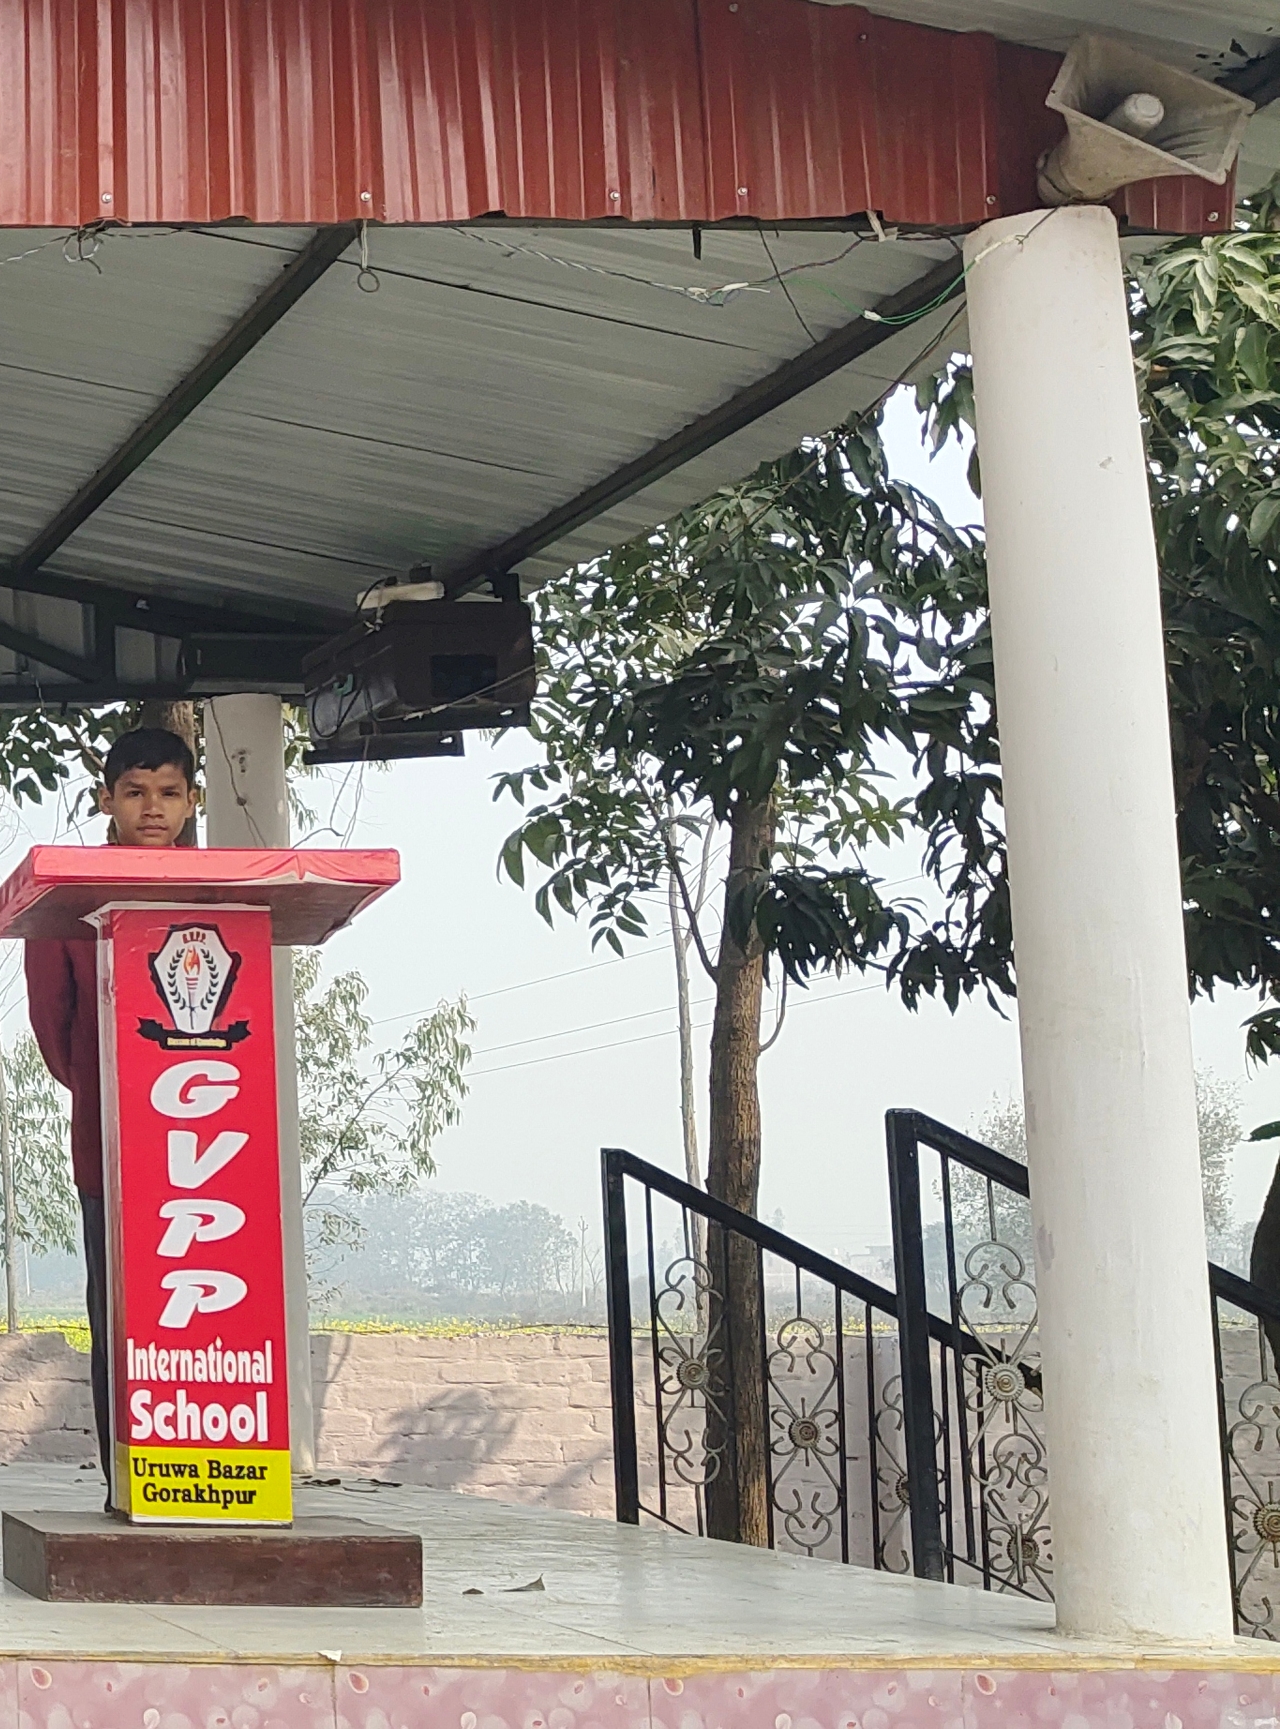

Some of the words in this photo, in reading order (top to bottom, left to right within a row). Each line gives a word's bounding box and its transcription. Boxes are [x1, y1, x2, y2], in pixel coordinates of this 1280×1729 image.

[127, 1335, 273, 1384] International
[130, 1389, 269, 1443] School
[132, 1457, 200, 1479] Uruwa
[206, 1459, 268, 1480] Bazar
[143, 1482, 256, 1510] Gorakhpur
